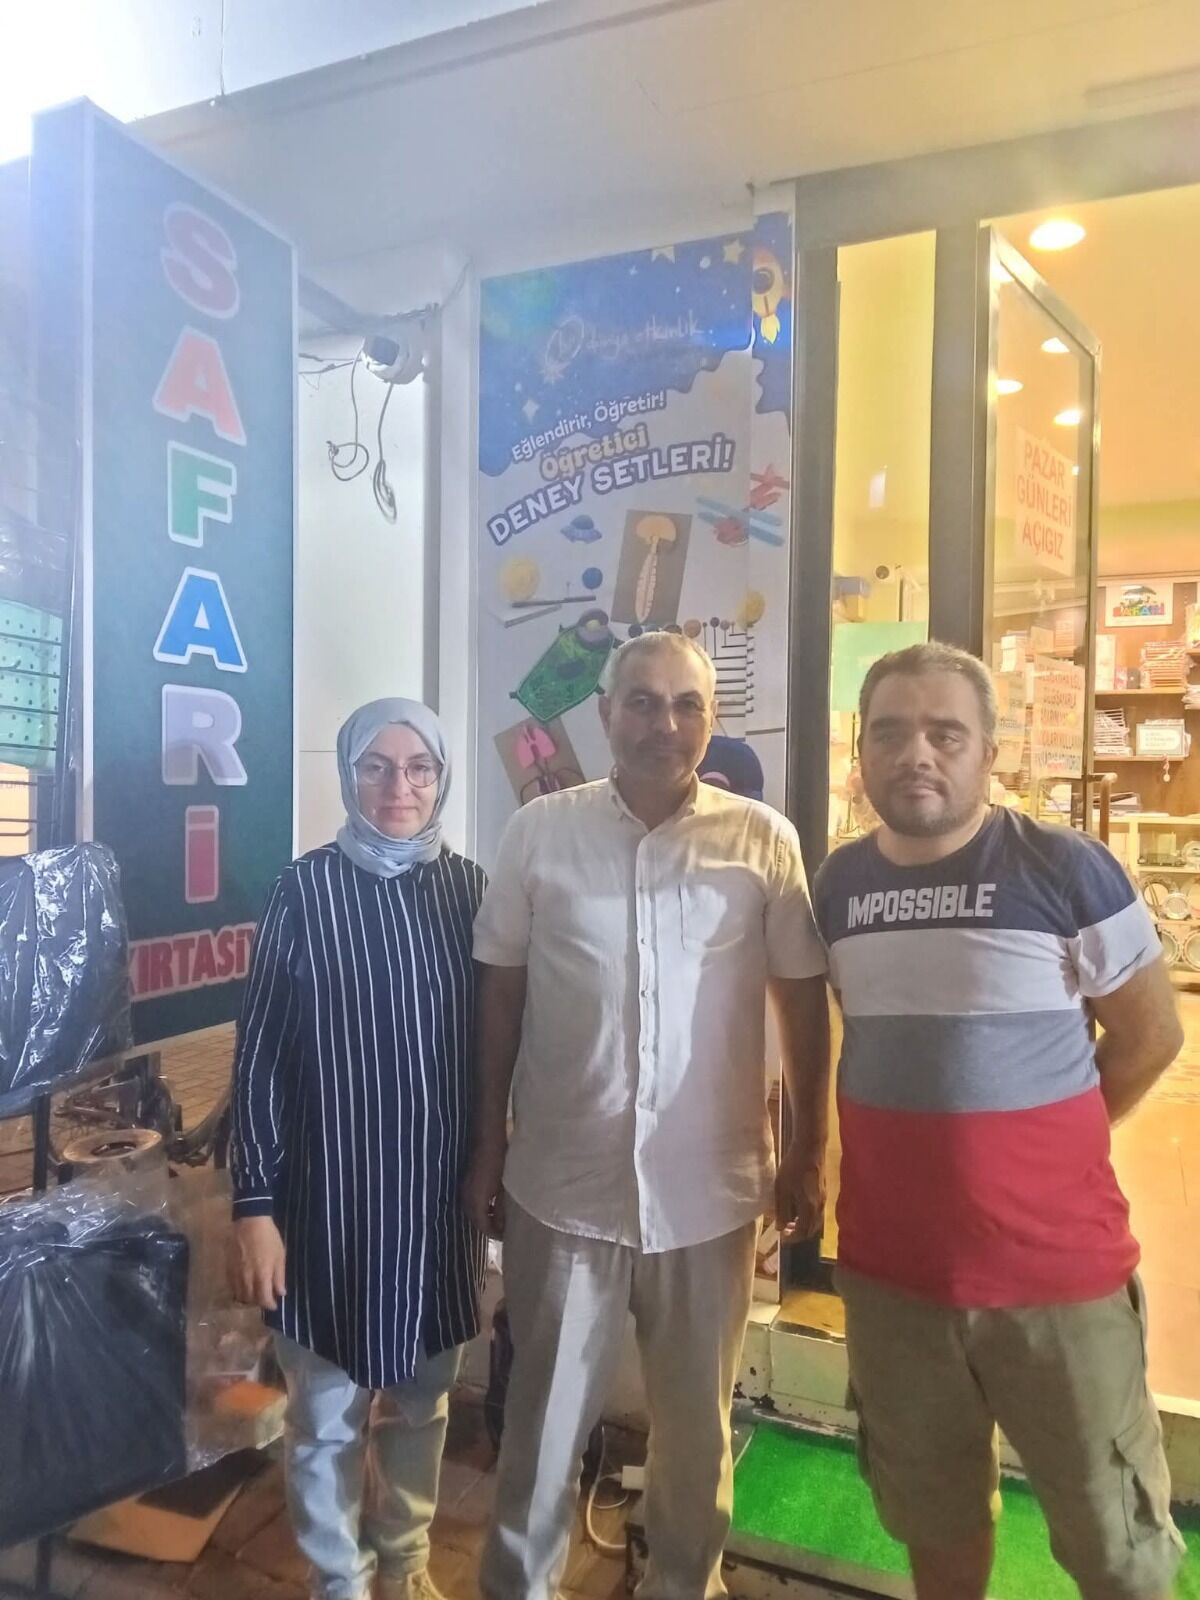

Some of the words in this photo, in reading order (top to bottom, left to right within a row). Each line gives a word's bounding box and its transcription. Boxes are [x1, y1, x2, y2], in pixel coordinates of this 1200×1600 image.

[511, 414, 593, 461] Eğlendirir,
[594, 391, 665, 423] Öğretir!
[541, 425, 648, 480] Öğretici
[488, 474, 585, 545] DENEY
[592, 433, 735, 494] SETLERİ!
[1024, 439, 1065, 490] PAZAR
[1016, 473, 1072, 528] GÜNLERİ
[847, 883, 997, 929] IMPOSSIBLE
